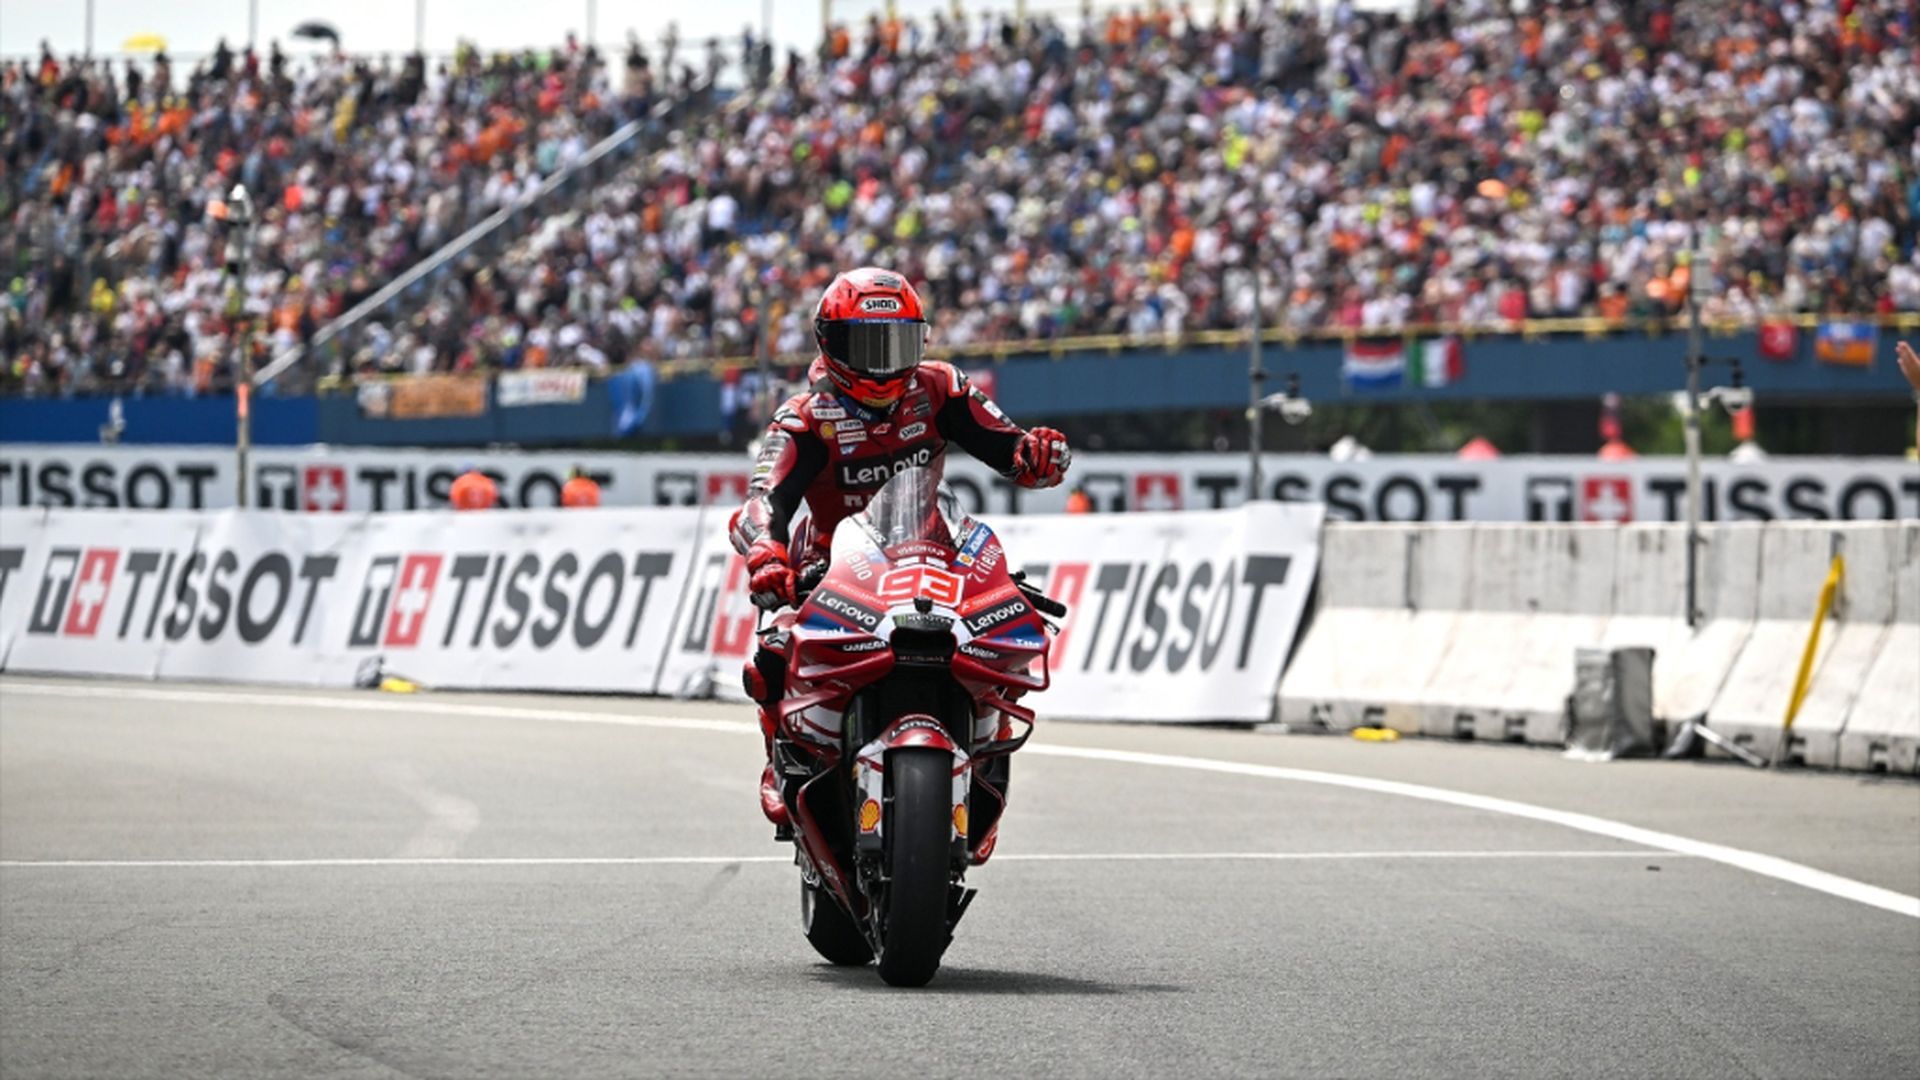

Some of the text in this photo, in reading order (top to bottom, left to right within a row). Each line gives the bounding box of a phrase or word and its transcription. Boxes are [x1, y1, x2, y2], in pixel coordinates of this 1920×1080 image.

[0, 461, 217, 511] ISSOT
[357, 467, 613, 512] TISO
[843, 448, 931, 485] Lenovo
[1194, 475, 1481, 522] TSSOT
[117, 551, 341, 645] TISSOT
[442, 549, 674, 649] TISSOT
[816, 591, 877, 626] Lenovo
[877, 564, 965, 608] 93
[966, 602, 1025, 632] Lenovo
[1082, 555, 1293, 674] TISSOT
